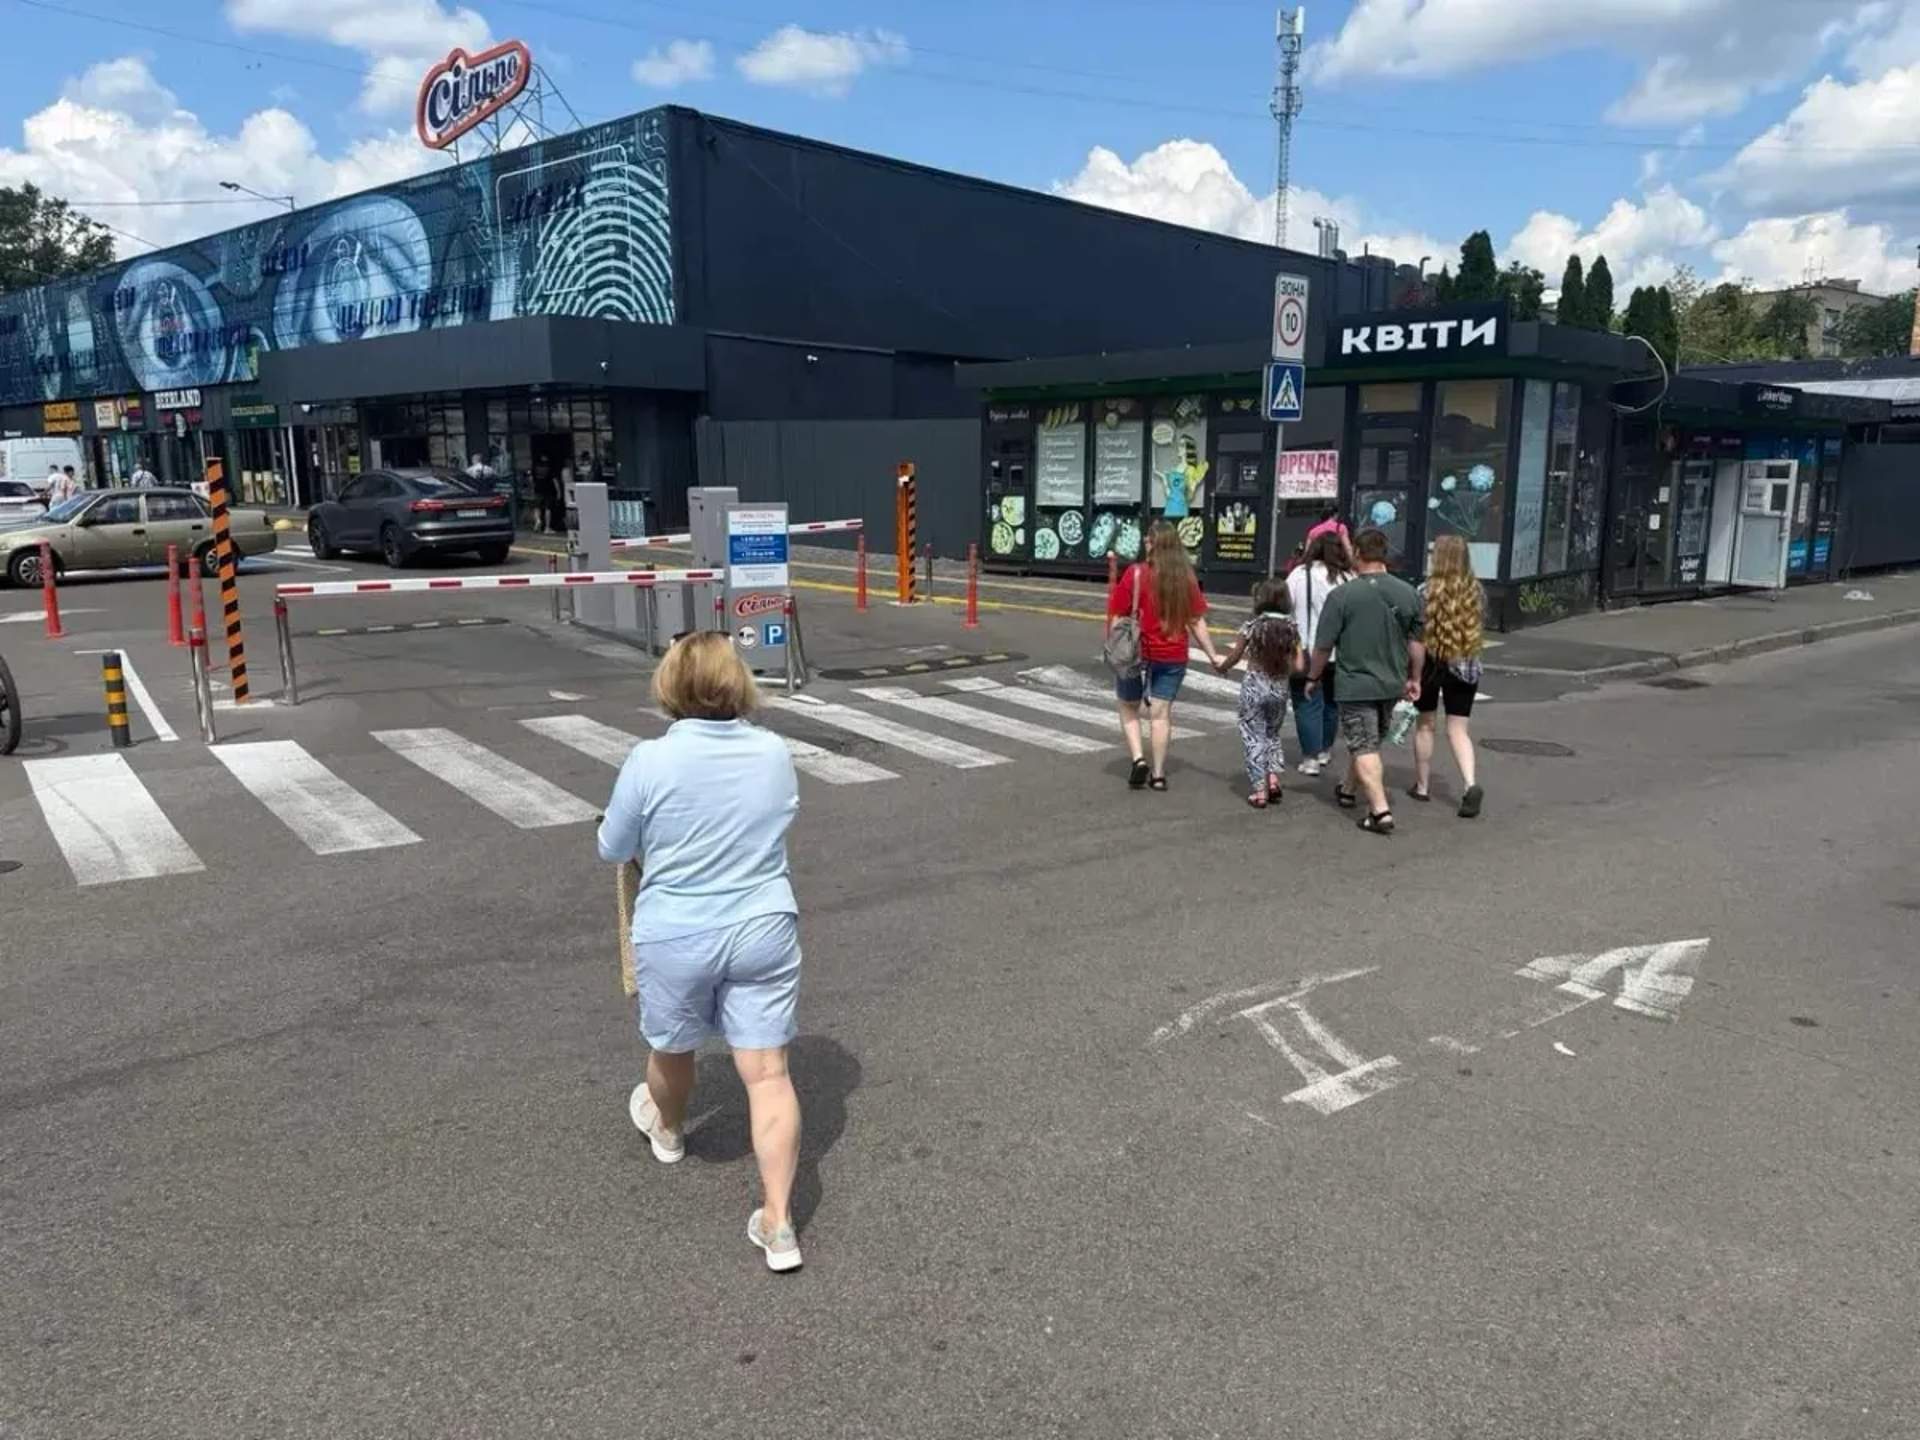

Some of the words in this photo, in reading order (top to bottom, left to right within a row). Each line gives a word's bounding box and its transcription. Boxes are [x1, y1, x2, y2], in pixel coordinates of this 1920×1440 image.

[428, 55, 518, 129] Сільпо
[1281, 281, 1305, 297] ЗОНА
[1286, 313, 1298, 332] 10
[1341, 317, 1497, 354] КВІТИ
[769, 626, 782, 644] P
